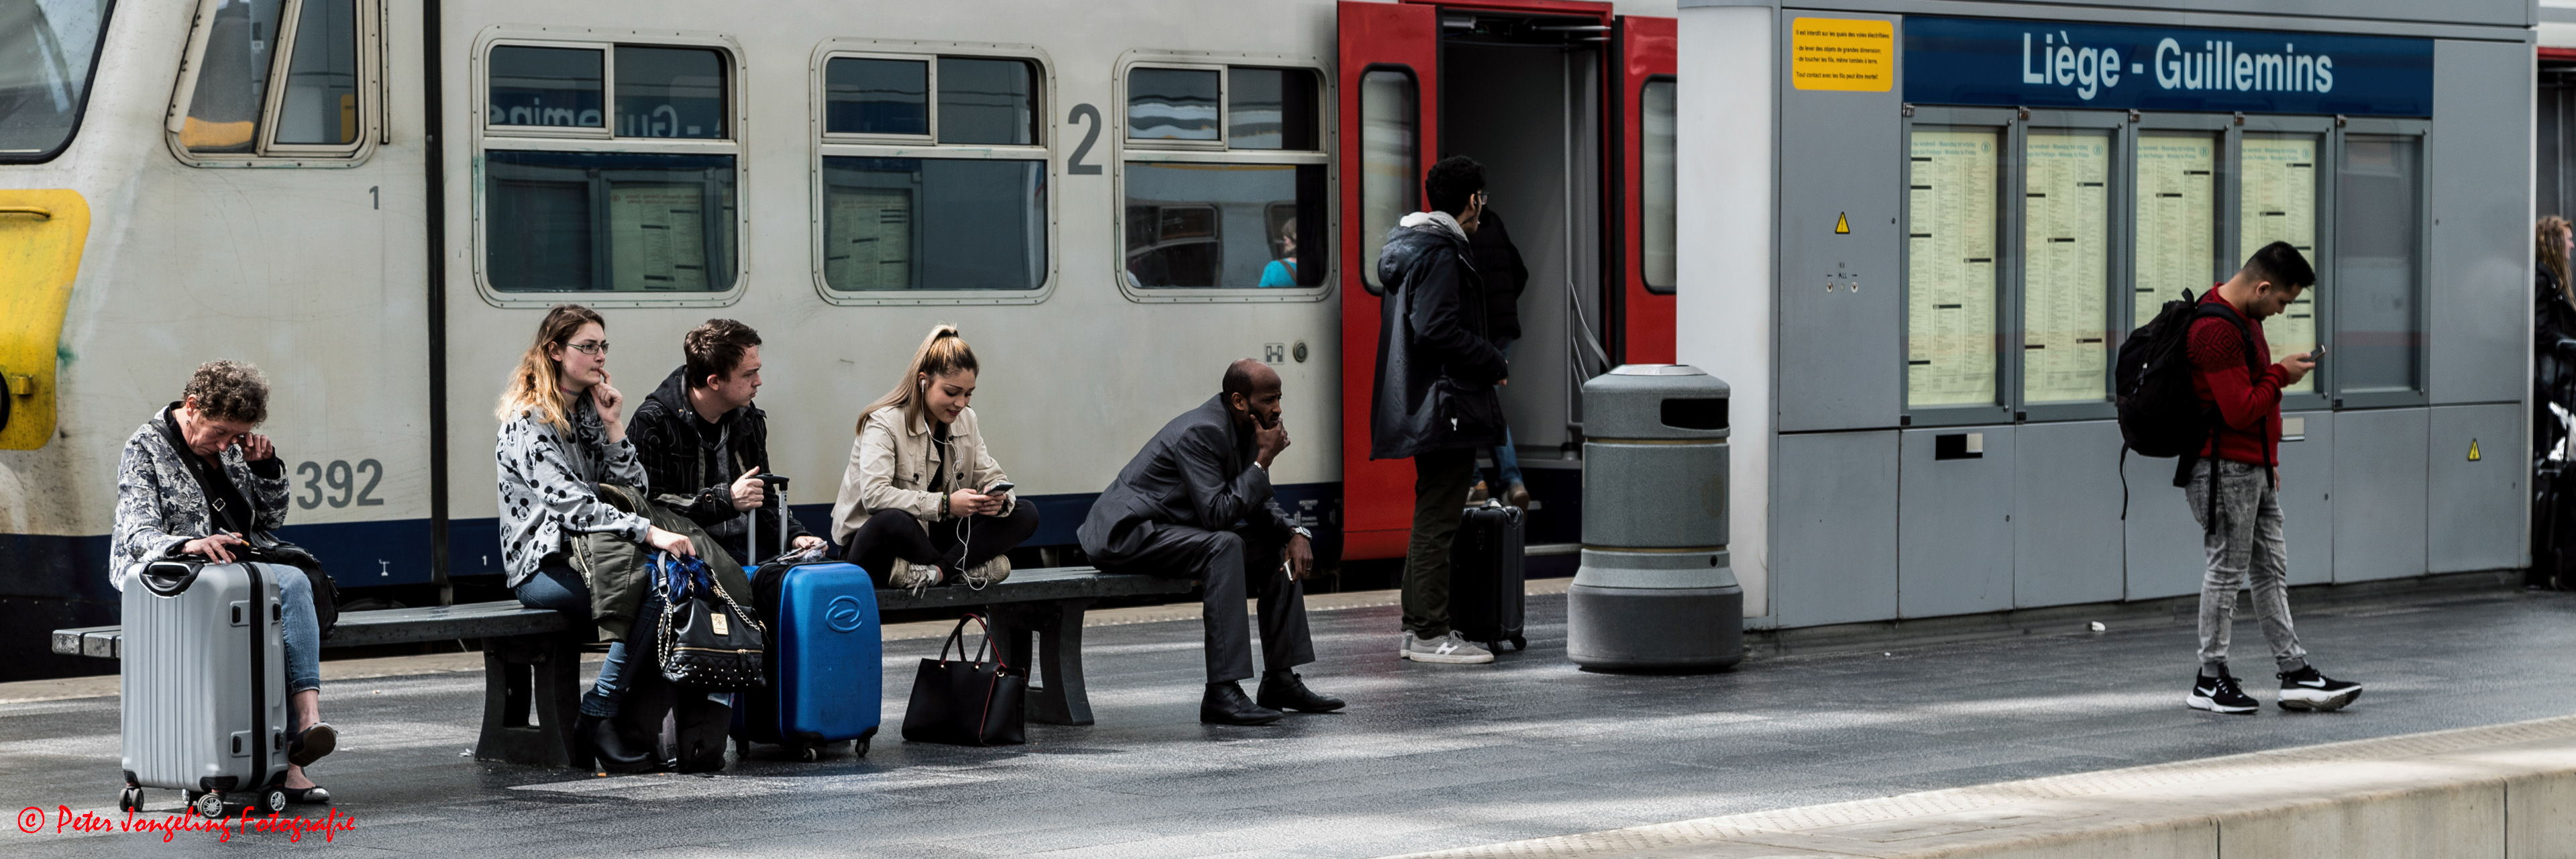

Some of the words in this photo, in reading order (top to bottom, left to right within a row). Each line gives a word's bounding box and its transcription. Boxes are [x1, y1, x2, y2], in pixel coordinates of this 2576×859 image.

[2023, 31, 2121, 100] Liège
[2132, 63, 2143, 74] -
[2155, 38, 2333, 93] Guillemins
[1068, 103, 1102, 175] 2
[369, 185, 379, 210] 1
[297, 458, 384, 510] 392
[482, 555, 487, 566] 1
